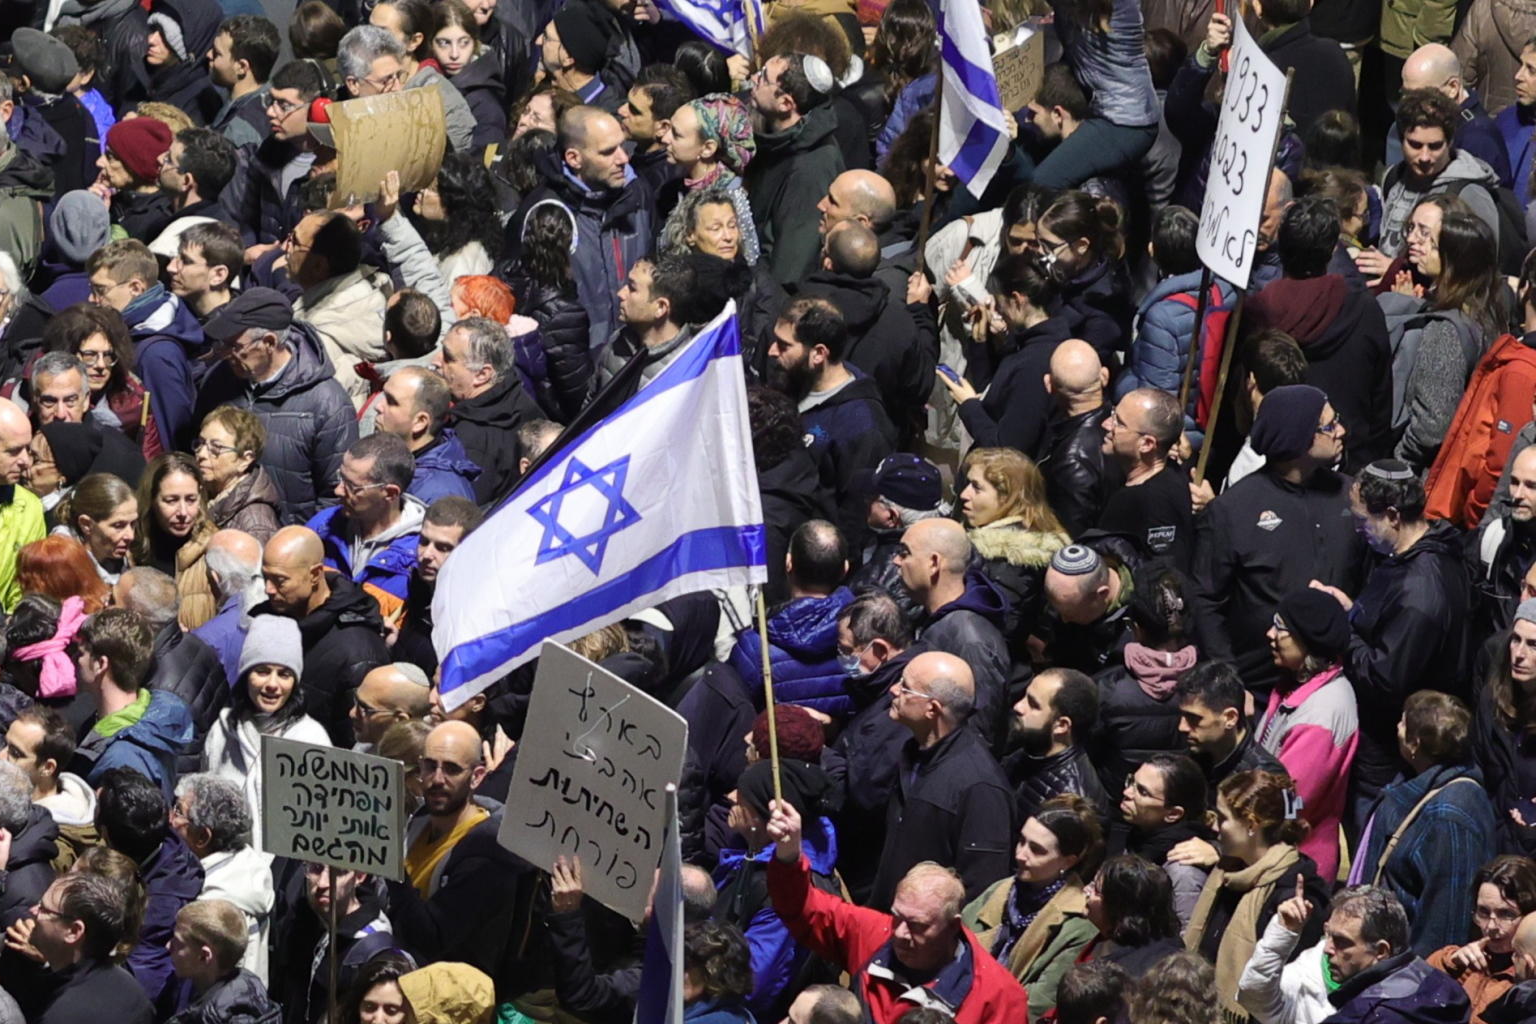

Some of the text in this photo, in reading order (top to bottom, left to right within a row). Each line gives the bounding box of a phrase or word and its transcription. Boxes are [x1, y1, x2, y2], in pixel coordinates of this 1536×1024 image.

[1225, 47, 1268, 133] 1933
[1222, 229, 1255, 268] לא
[568, 686, 662, 760] בארץ
[275, 749, 389, 790] הממשלה
[292, 783, 392, 813] מפחידה
[529, 768, 651, 850] השחיתות
[282, 805, 390, 840] אותי יותר
[292, 833, 388, 865] מהגשם
[525, 811, 637, 889] פורחת
